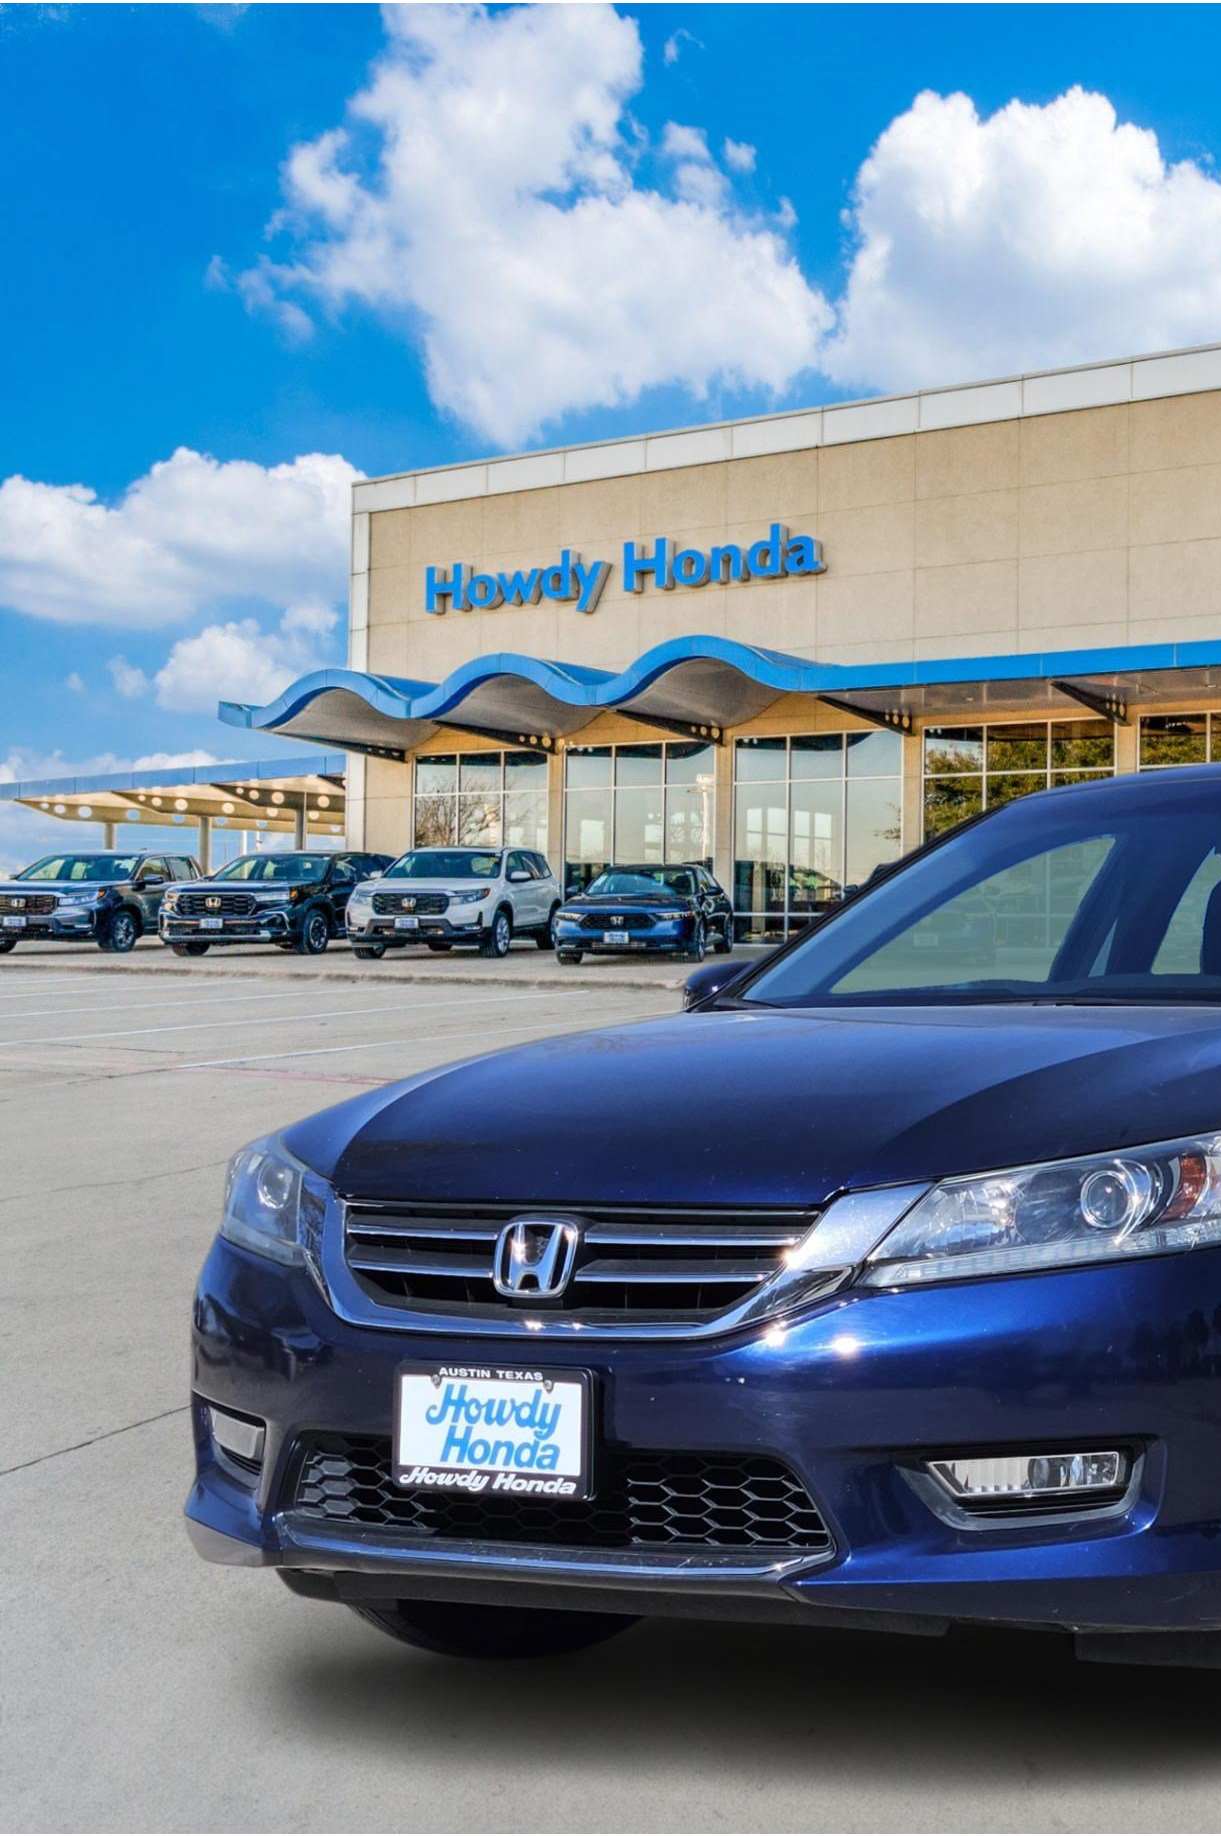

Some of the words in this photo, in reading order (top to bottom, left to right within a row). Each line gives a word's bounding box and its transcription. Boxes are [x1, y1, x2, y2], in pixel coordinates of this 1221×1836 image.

[425, 549, 612, 615] Howdy
[623, 523, 827, 594] Honda
[439, 1367, 491, 1379] AUSTIN
[496, 1370, 543, 1381] TEXAS
[425, 1383, 562, 1440] Howdy
[440, 1425, 561, 1470] Honda
[400, 1466, 490, 1491] Howdy
[492, 1471, 577, 1495] Honda
